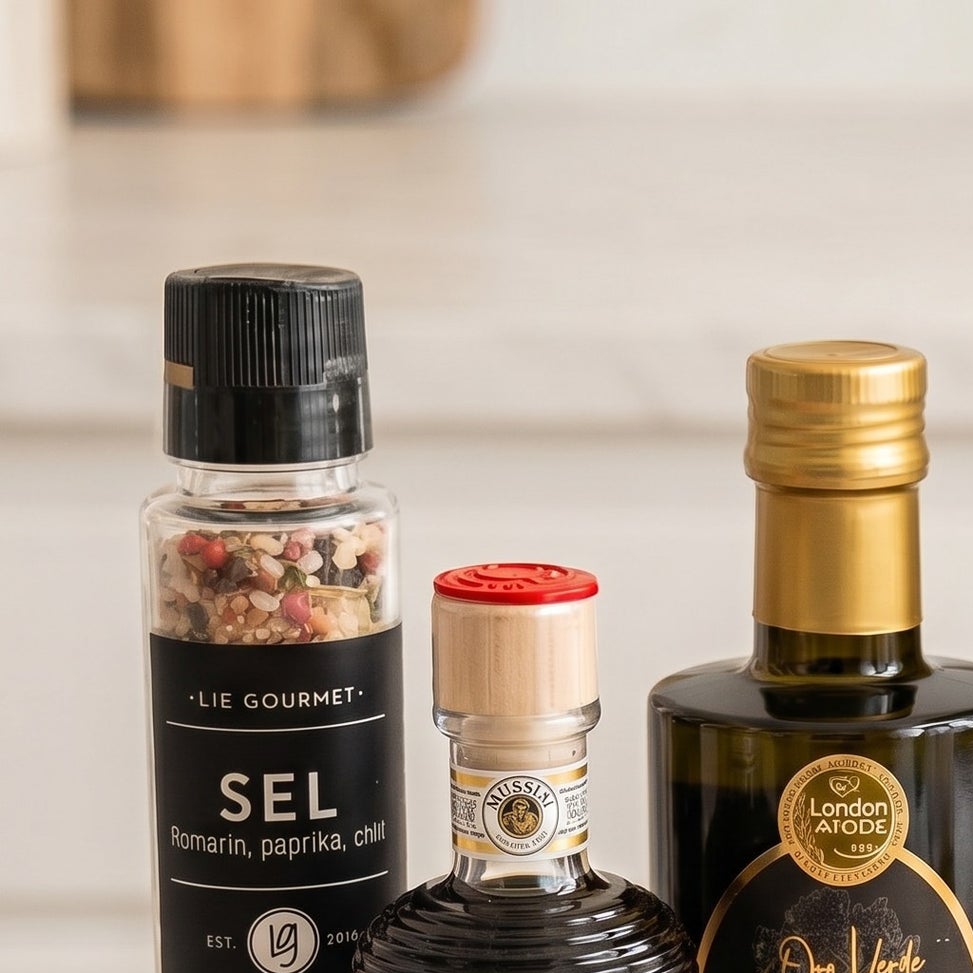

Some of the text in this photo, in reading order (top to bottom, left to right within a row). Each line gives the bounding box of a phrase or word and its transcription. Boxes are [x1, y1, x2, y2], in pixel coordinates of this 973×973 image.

[199, 686, 354, 709] LIE GOURMET
[219, 771, 337, 822] SEL
[811, 797, 887, 817] London
[171, 825, 252, 858] Romarin,
[261, 830, 346, 861] paprika,
[206, 929, 358, 949] EST. 2016
